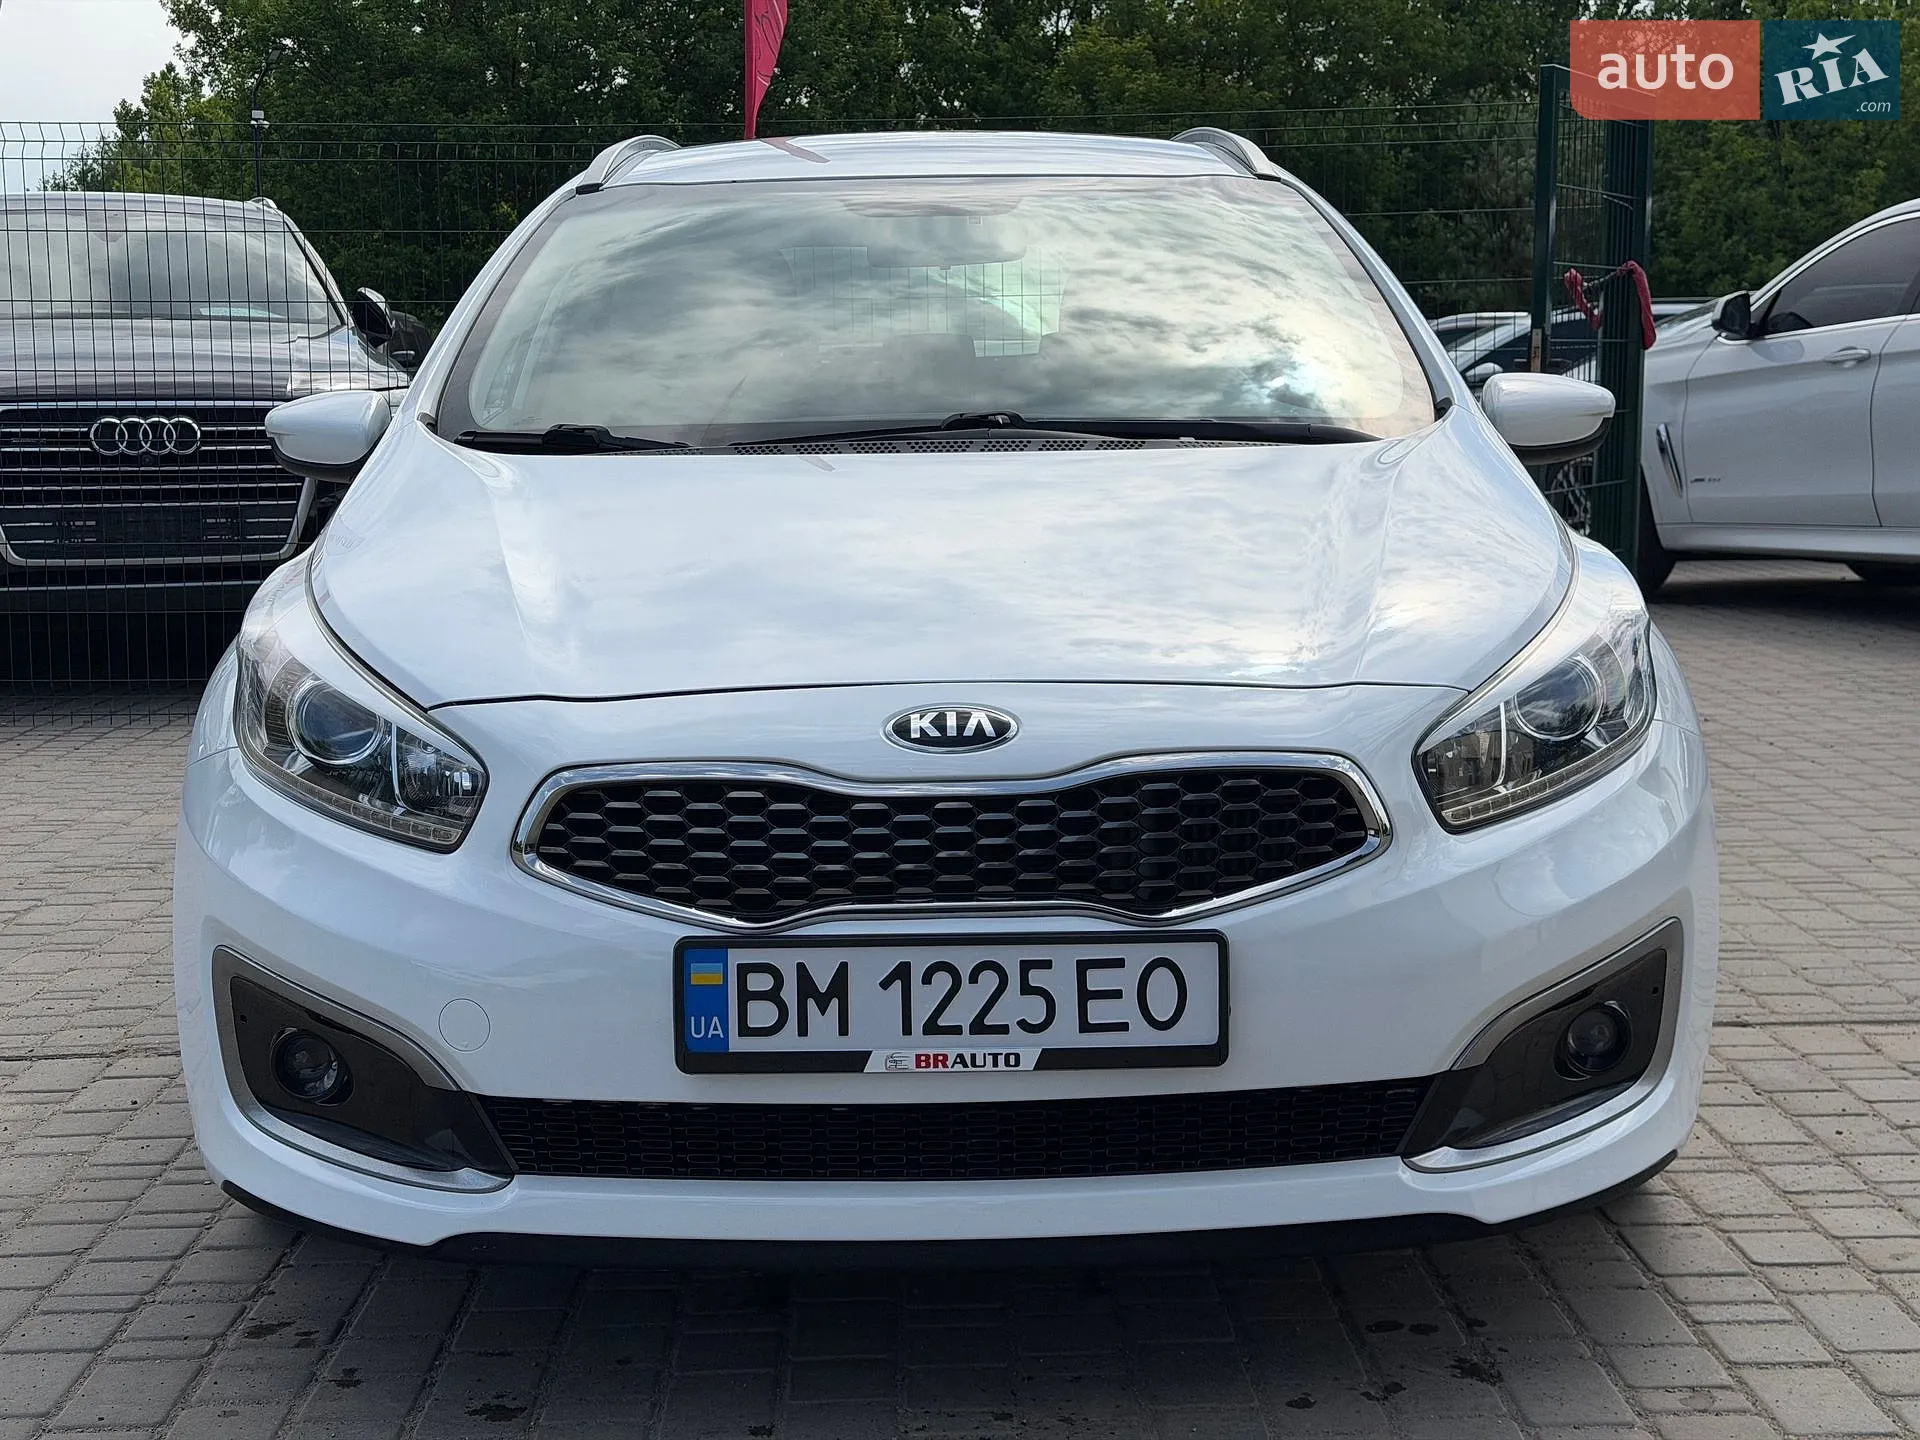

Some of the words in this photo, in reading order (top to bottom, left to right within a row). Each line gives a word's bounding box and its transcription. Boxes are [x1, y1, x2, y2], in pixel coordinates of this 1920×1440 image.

[909, 711, 997, 739] KIA
[735, 960, 849, 1038] BM
[878, 958, 1057, 1037] 1225
[1076, 956, 1189, 1035] EO
[690, 1015, 724, 1039] UA
